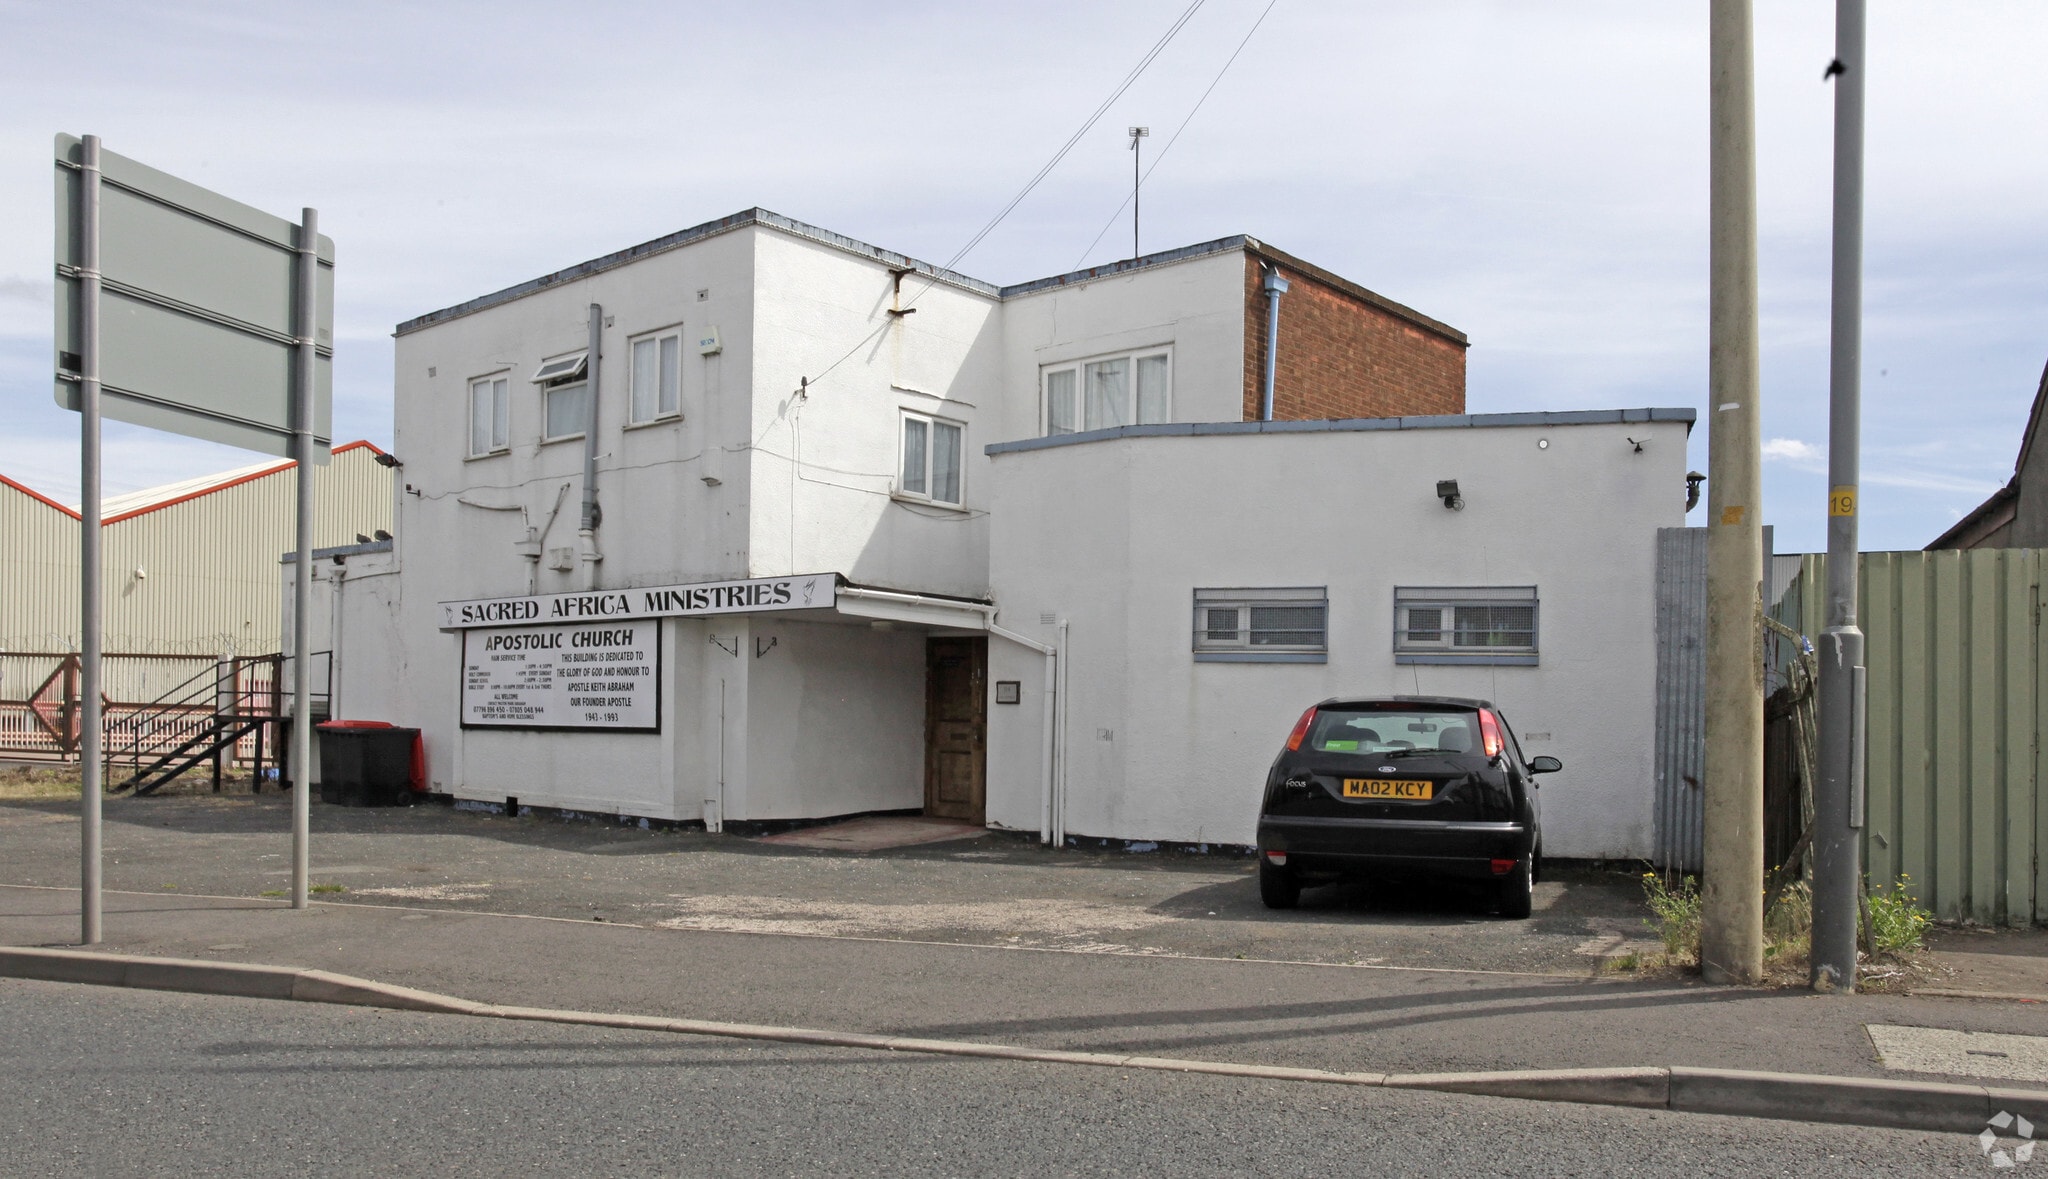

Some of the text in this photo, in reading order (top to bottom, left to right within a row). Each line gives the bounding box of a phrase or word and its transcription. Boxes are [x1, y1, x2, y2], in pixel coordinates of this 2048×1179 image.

[1830, 496, 1853, 513] 19
[462, 582, 792, 624] SACRED AFRICA MINISTRIES
[485, 629, 634, 651] APOSTOLIC CHURCH
[561, 651, 644, 662] THIS BUILDING IS DEDICATED TO
[557, 666, 649, 677] THE GLORY OF GOD AND HONOUR TO
[568, 682, 634, 691] APOSTLE KEITH ABRAHAM
[570, 697, 632, 707] OUR FOUNDER APOSTLE
[585, 712, 598, 721] 1943
[604, 712, 619, 721] 1993
[1350, 781, 1426, 796] MA02 KCY
